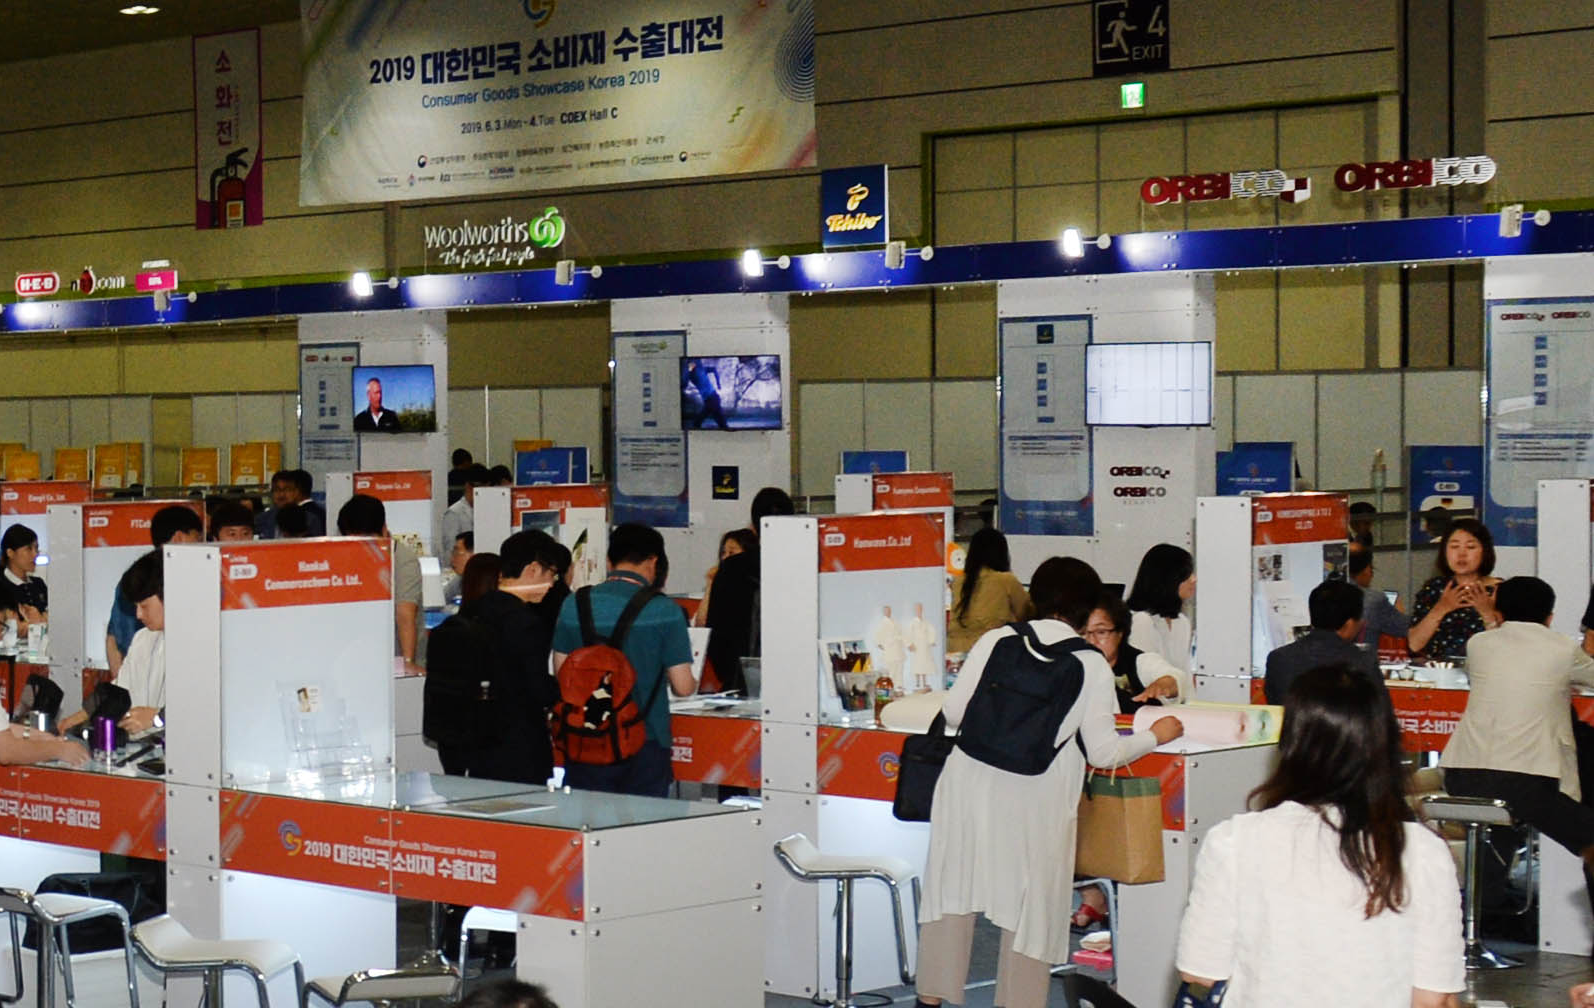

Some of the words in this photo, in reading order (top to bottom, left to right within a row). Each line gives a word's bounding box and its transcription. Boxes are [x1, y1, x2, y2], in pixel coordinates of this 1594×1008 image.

[1148, 5, 1166, 37] 4
[369, 55, 416, 85] 2019
[421, 40, 521, 85] 대한민국
[527, 30, 607, 75] 소비재
[612, 15, 724, 62] 수출대전
[1132, 43, 1164, 60] EXIT
[422, 91, 479, 109] Consumer
[482, 84, 520, 103] Goods
[523, 77, 586, 100] Showcase
[588, 73, 626, 91] Korea
[629, 69, 661, 86] 2019
[560, 110, 587, 126] COEX
[611, 107, 618, 119] C
[1141, 169, 1288, 205] ORBICO
[1334, 154, 1498, 192] ORBICO
[424, 216, 529, 248] Woolworths
[1110, 466, 1162, 477] ORBICO
[1113, 486, 1166, 498] ORBICO
[20, 802, 54, 823] 소비재
[55, 806, 101, 829] 수출대전
[363, 835, 397, 848] Consumer
[303, 840, 331, 859] 2019
[333, 843, 390, 871] 대한민국
[392, 854, 436, 877] 소비재
[437, 859, 498, 885] 수출대전
